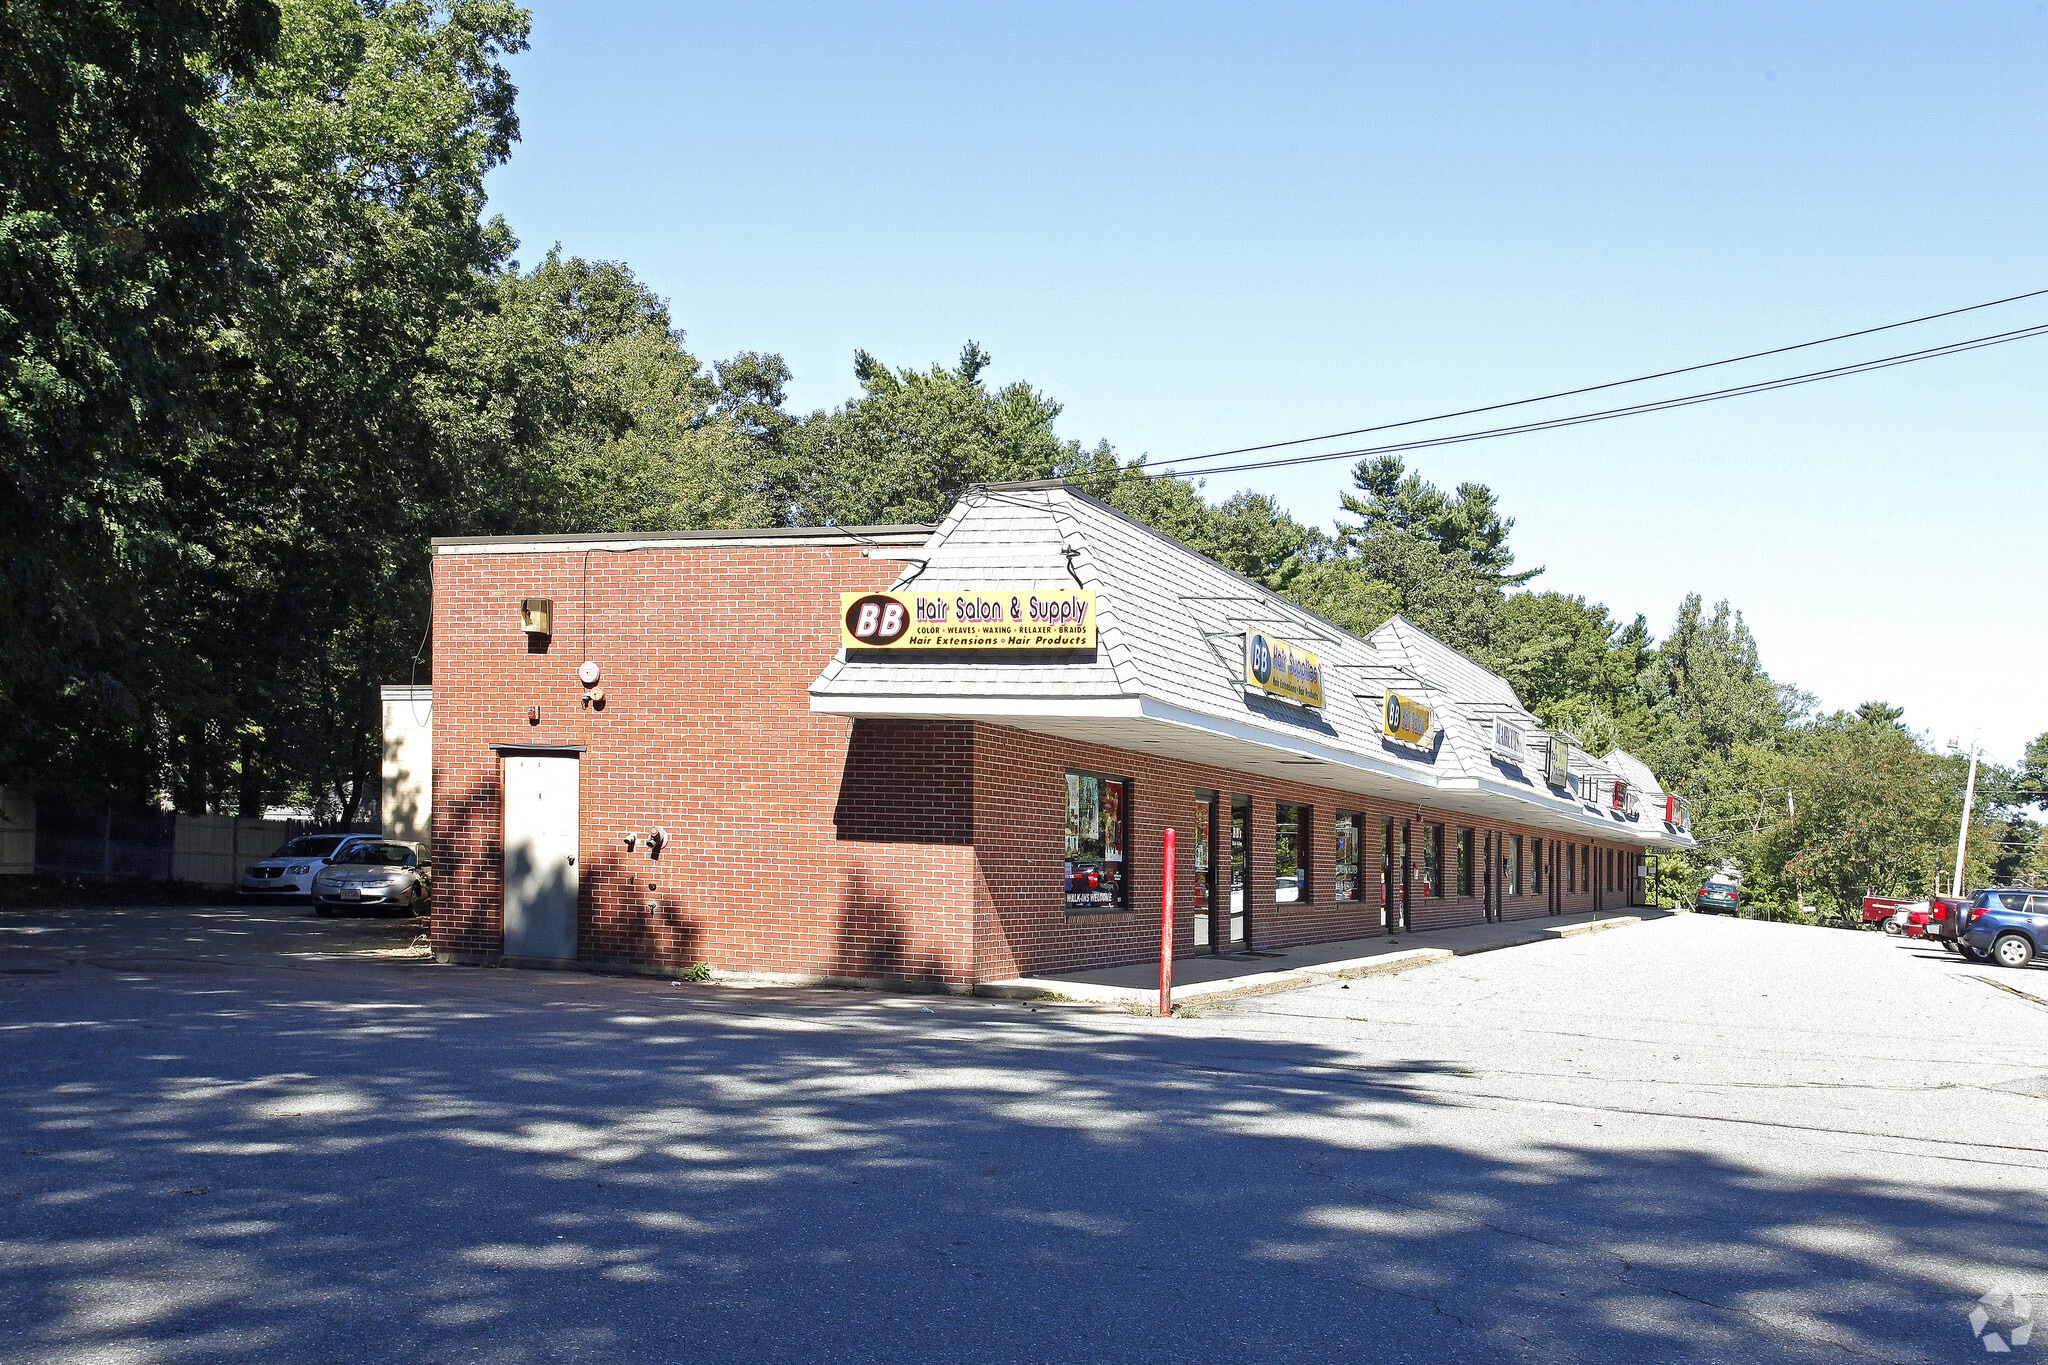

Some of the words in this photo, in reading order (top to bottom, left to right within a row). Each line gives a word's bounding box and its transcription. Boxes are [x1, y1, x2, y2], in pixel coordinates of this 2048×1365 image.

[854, 602, 905, 638] BB
[916, 597, 949, 622] Hair
[955, 596, 1003, 623] Salon
[1010, 596, 1023, 622] &
[1029, 595, 1088, 626] Supply
[909, 636, 931, 645] Hair
[936, 635, 998, 645] Extensions
[1008, 635, 1031, 645] Hair
[1035, 634, 1087, 645] Products
[917, 626, 940, 634] COLOR
[947, 626, 976, 634] WEAVES
[982, 626, 1012, 634] WAXING
[1019, 626, 1051, 634] RELAXER
[1058, 626, 1087, 634] BRAIDS
[1253, 644, 1268, 673] BB
[1273, 644, 1287, 672] Hair
[1289, 652, 1319, 684] Supplies
[1388, 703, 1400, 727] BB
